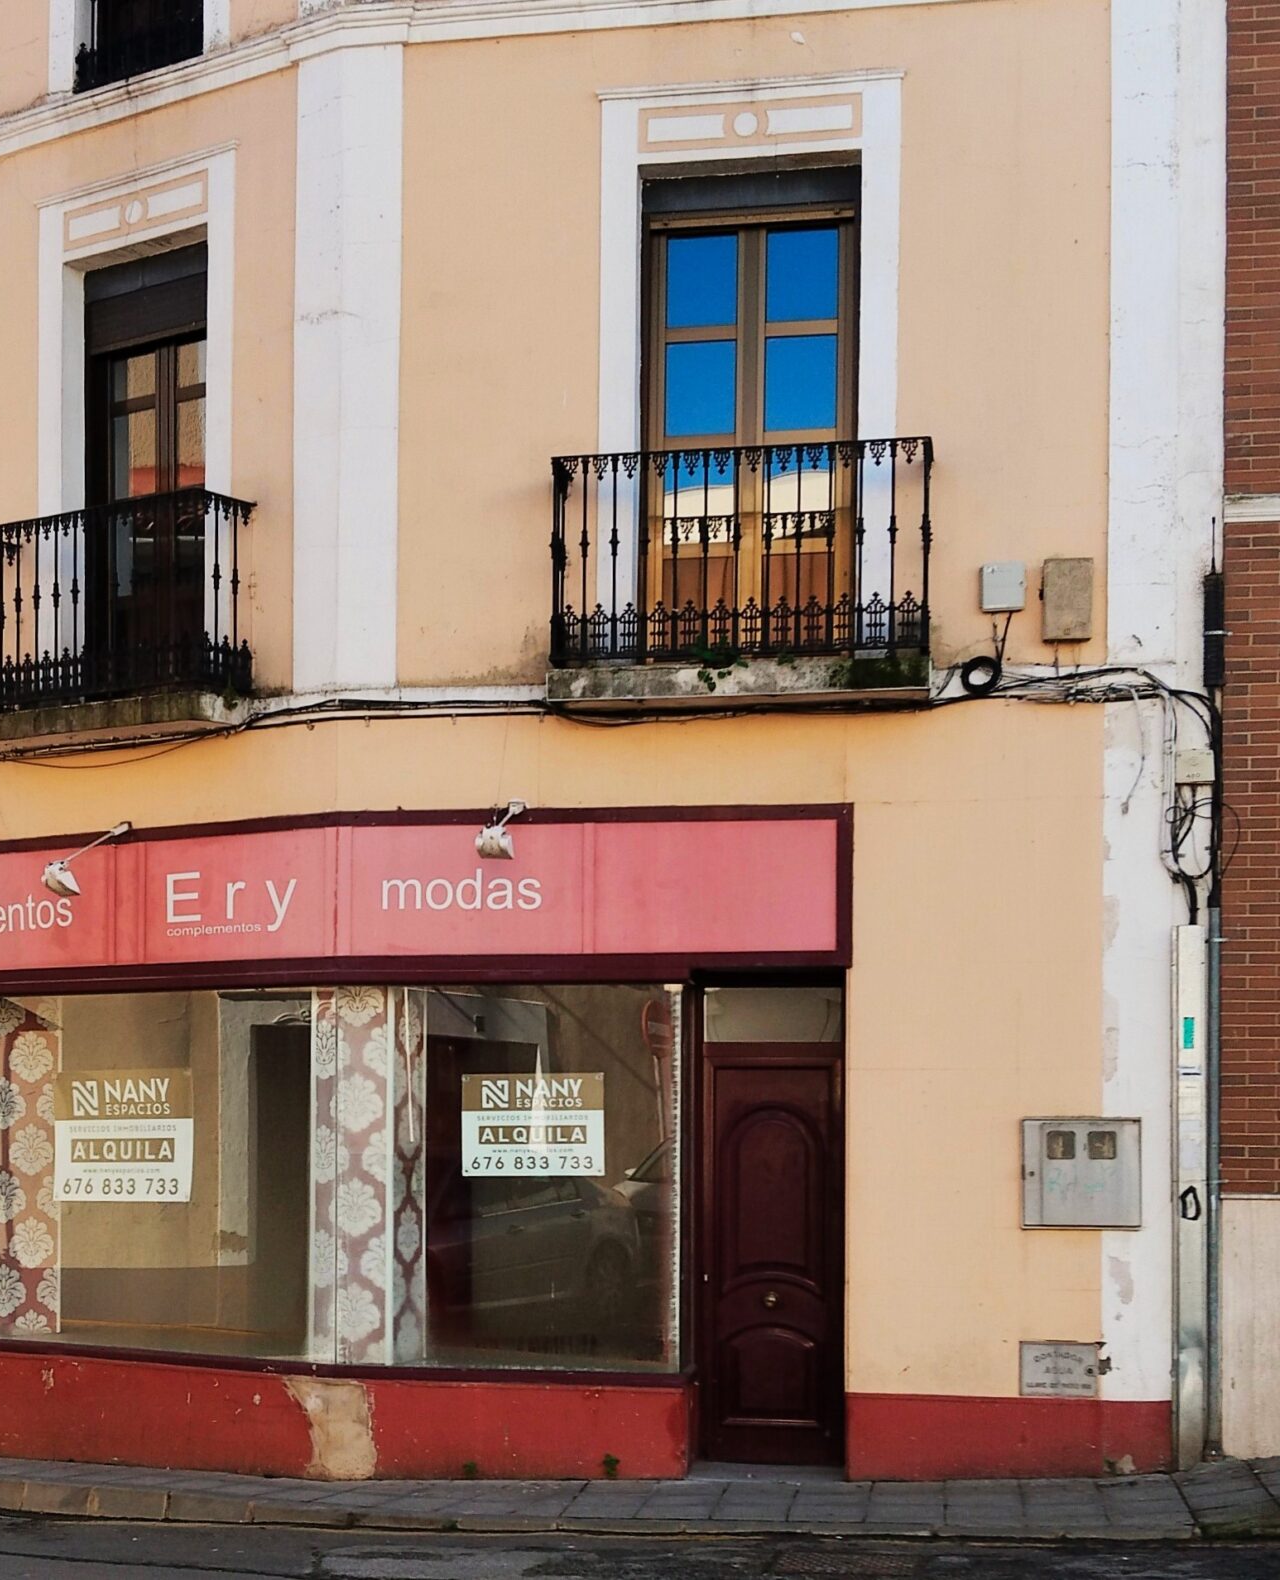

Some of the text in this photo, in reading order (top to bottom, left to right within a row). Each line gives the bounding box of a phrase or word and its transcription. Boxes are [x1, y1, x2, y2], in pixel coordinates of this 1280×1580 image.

[381, 868, 543, 911] modas
[166, 923, 261, 937] complementos
[104, 1078, 170, 1103] NANY
[516, 1078, 583, 1098] NANY
[105, 1103, 171, 1116] ESPACIOS
[516, 1098, 583, 1108] ESPACIOS
[481, 1127, 586, 1143] ALQUILA
[73, 1140, 173, 1160] ALQUILA
[471, 1156, 593, 1169] 676 833 733
[63, 1178, 179, 1195] 676 833 733
